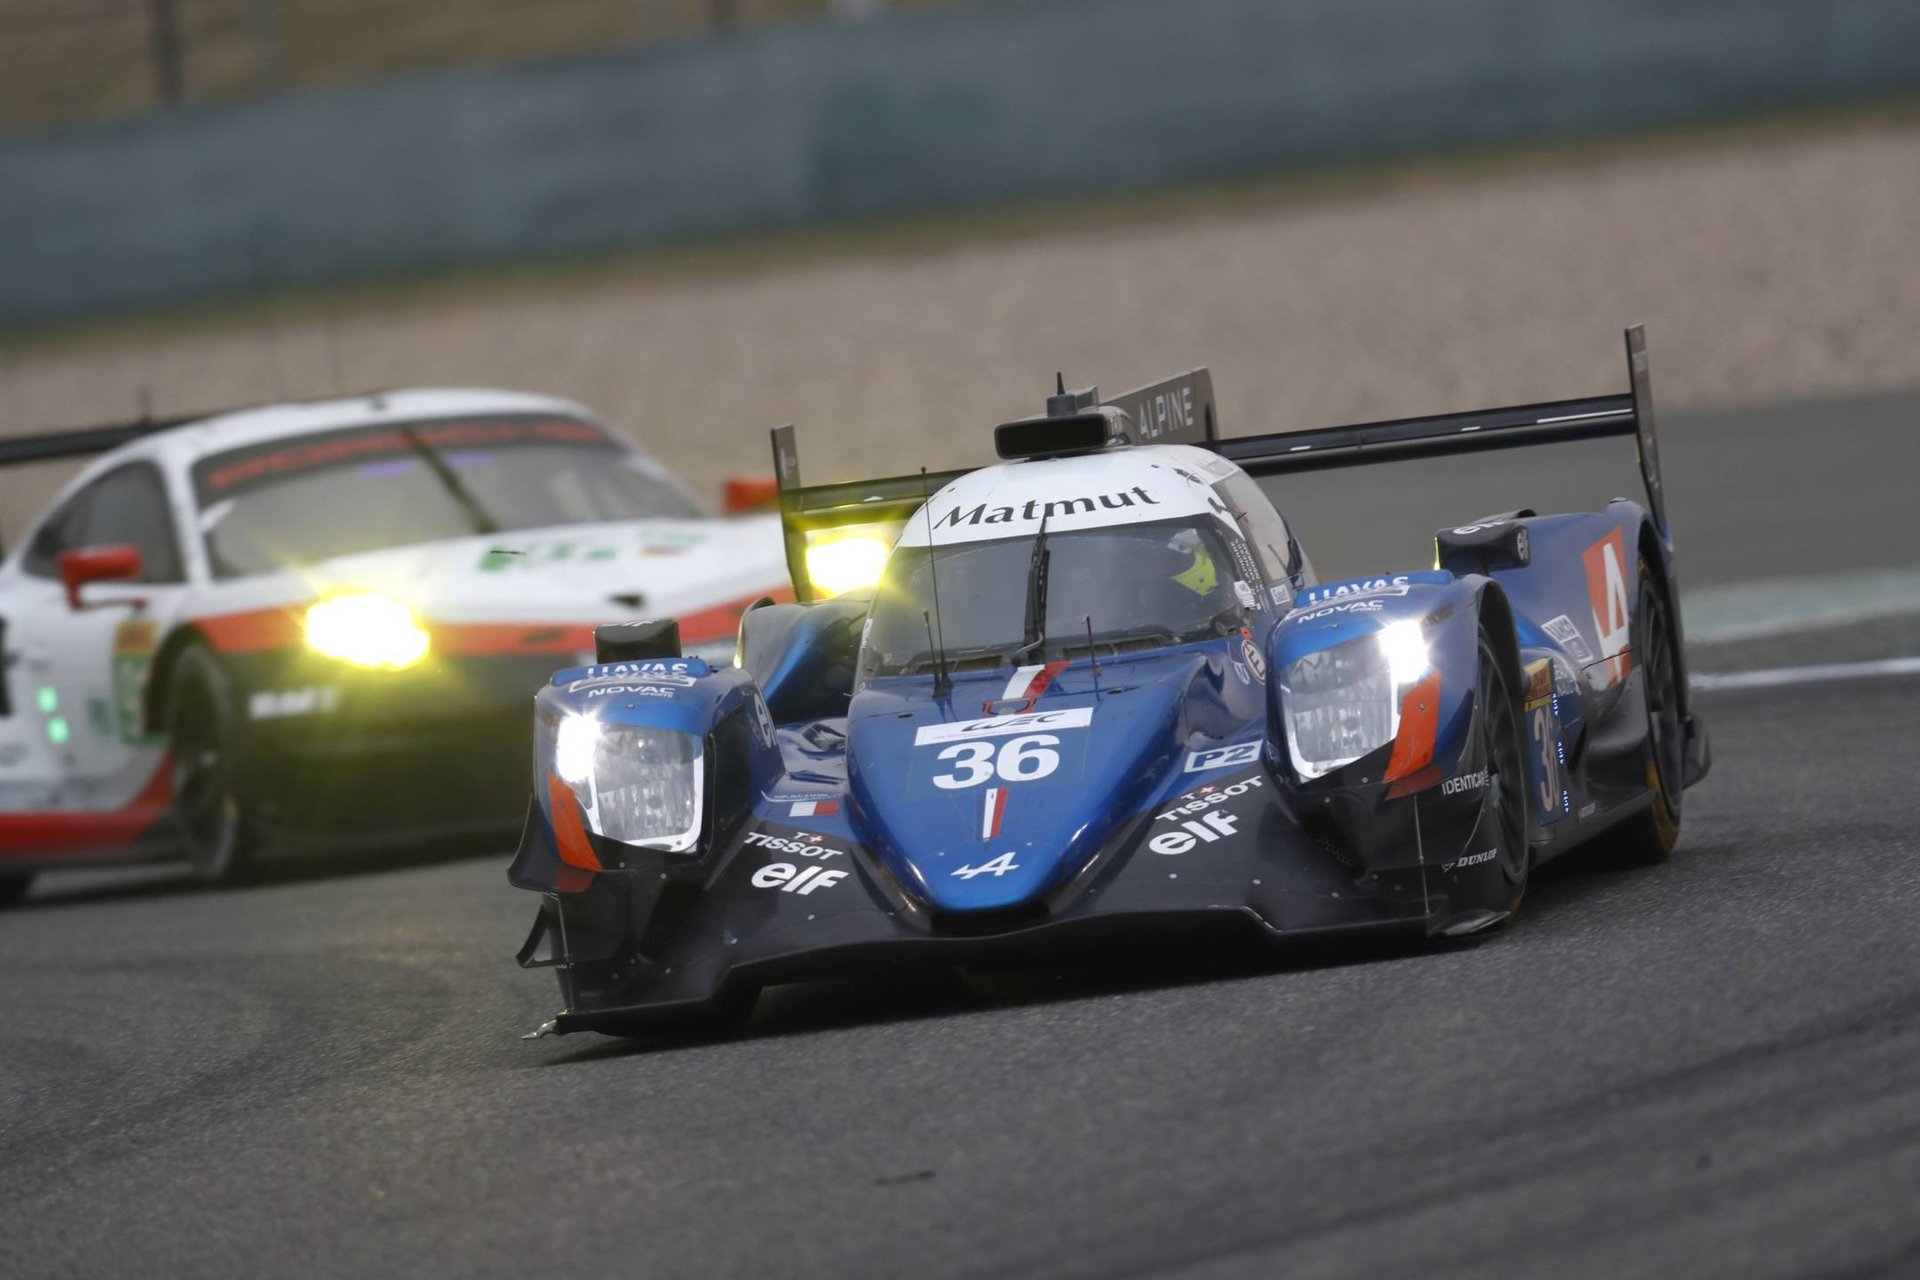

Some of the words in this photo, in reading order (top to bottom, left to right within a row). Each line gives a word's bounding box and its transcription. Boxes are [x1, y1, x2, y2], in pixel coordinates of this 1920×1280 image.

[1140, 387, 1193, 440] ALPINE
[932, 486, 1161, 530] Matmut
[1298, 600, 1384, 624] NOVAC
[588, 686, 675, 698] NOVAC
[961, 712, 1066, 732] WEC
[932, 734, 1060, 790] 36
[1192, 745, 1256, 768] P2
[1155, 775, 1262, 821] TISSOT
[744, 832, 844, 860] TISSOT
[1149, 810, 1239, 855] elf
[751, 862, 849, 896] elf
